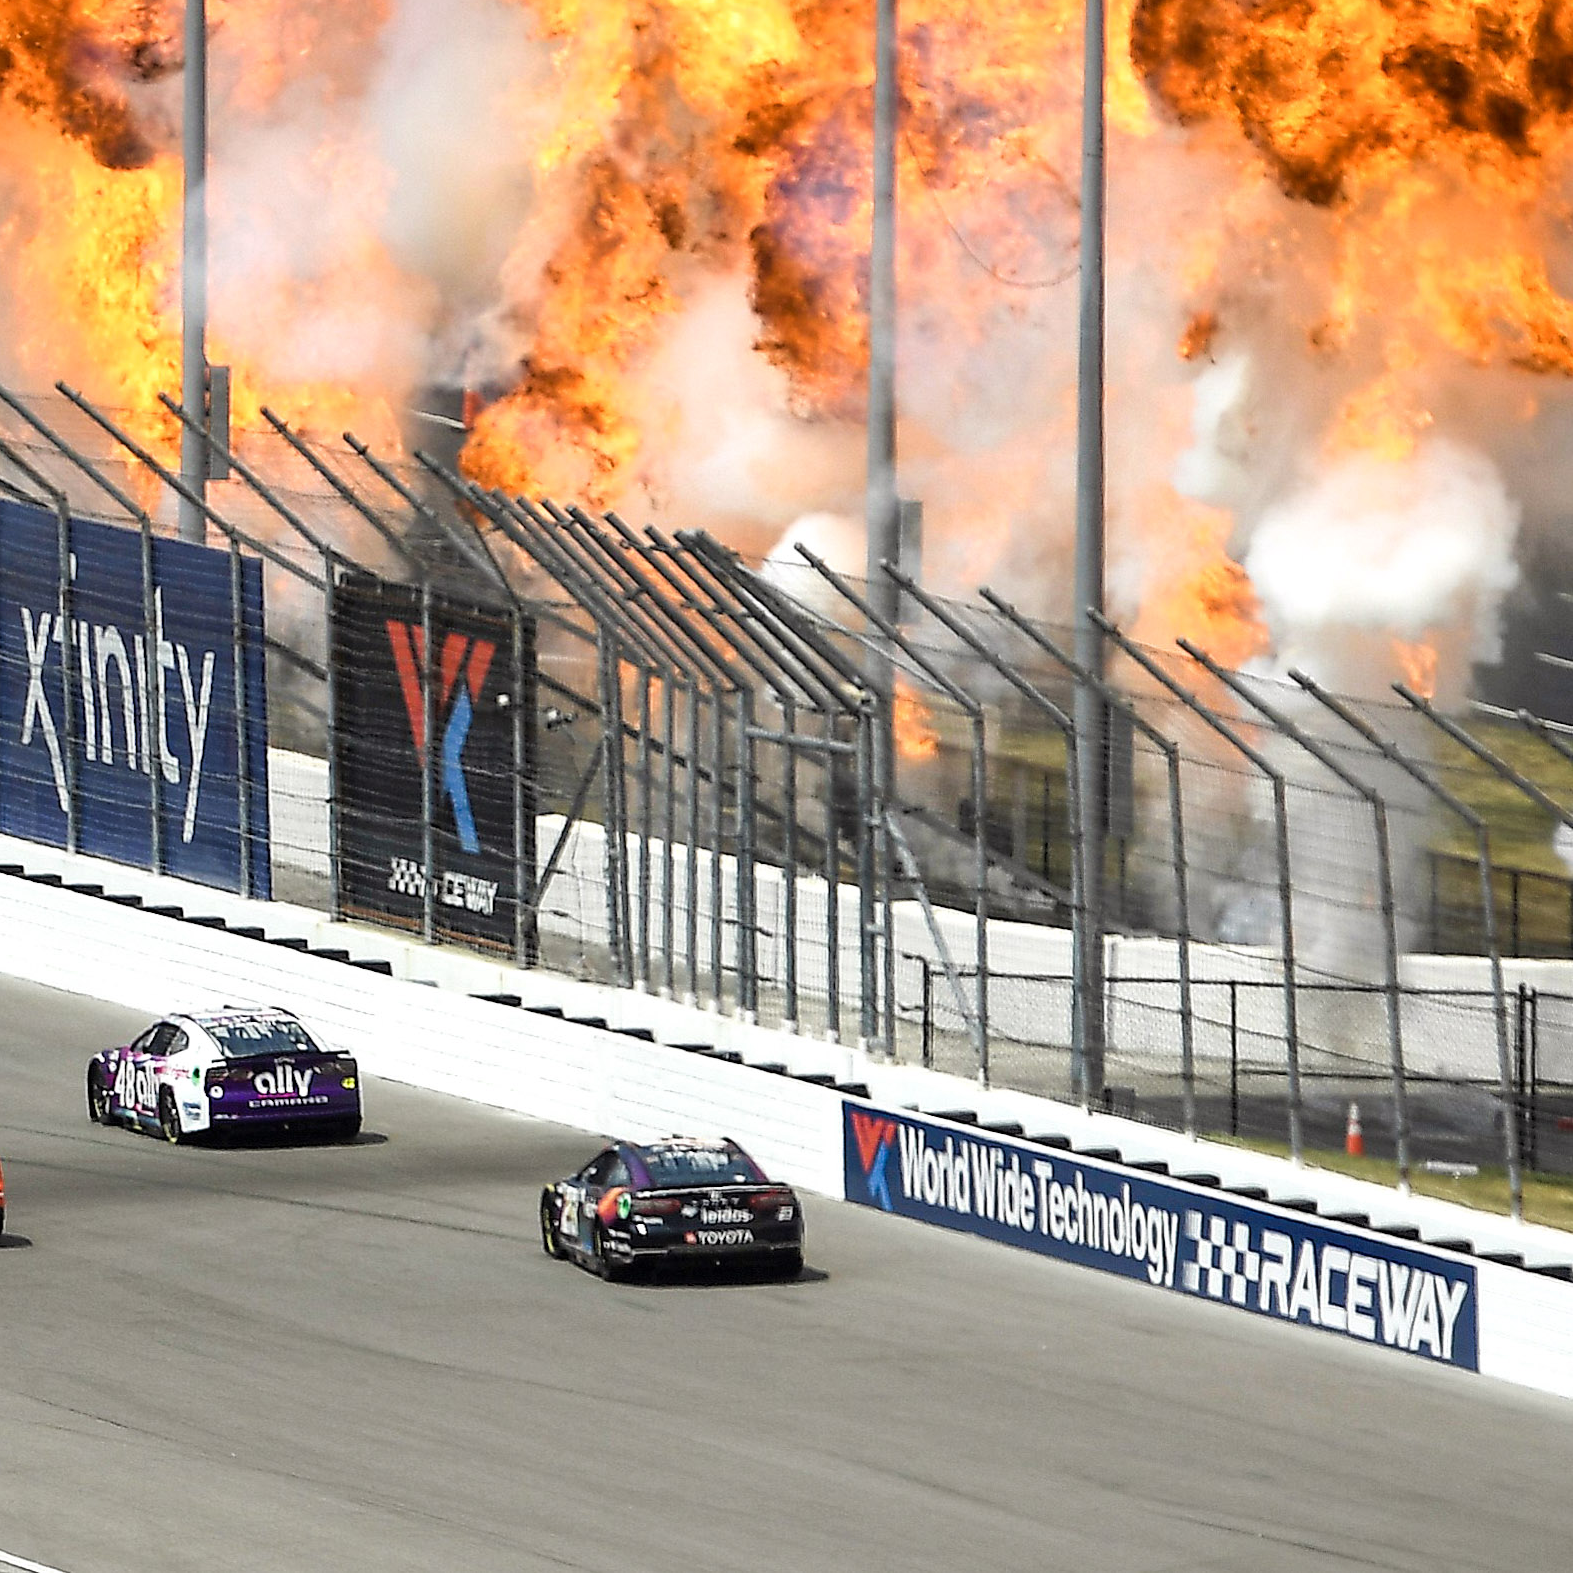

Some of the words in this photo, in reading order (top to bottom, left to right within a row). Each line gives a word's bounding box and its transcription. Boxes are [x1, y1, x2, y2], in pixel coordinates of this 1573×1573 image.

[115, 1059, 135, 1109] 48
[254, 1060, 315, 1097] ally
[697, 1229, 754, 1245] TOYOTA
[898, 1123, 972, 1215] World
[969, 1141, 1036, 1233] Wide
[1031, 1157, 1180, 1288] Technology
[1258, 1228, 1468, 1361] RACEWAY
